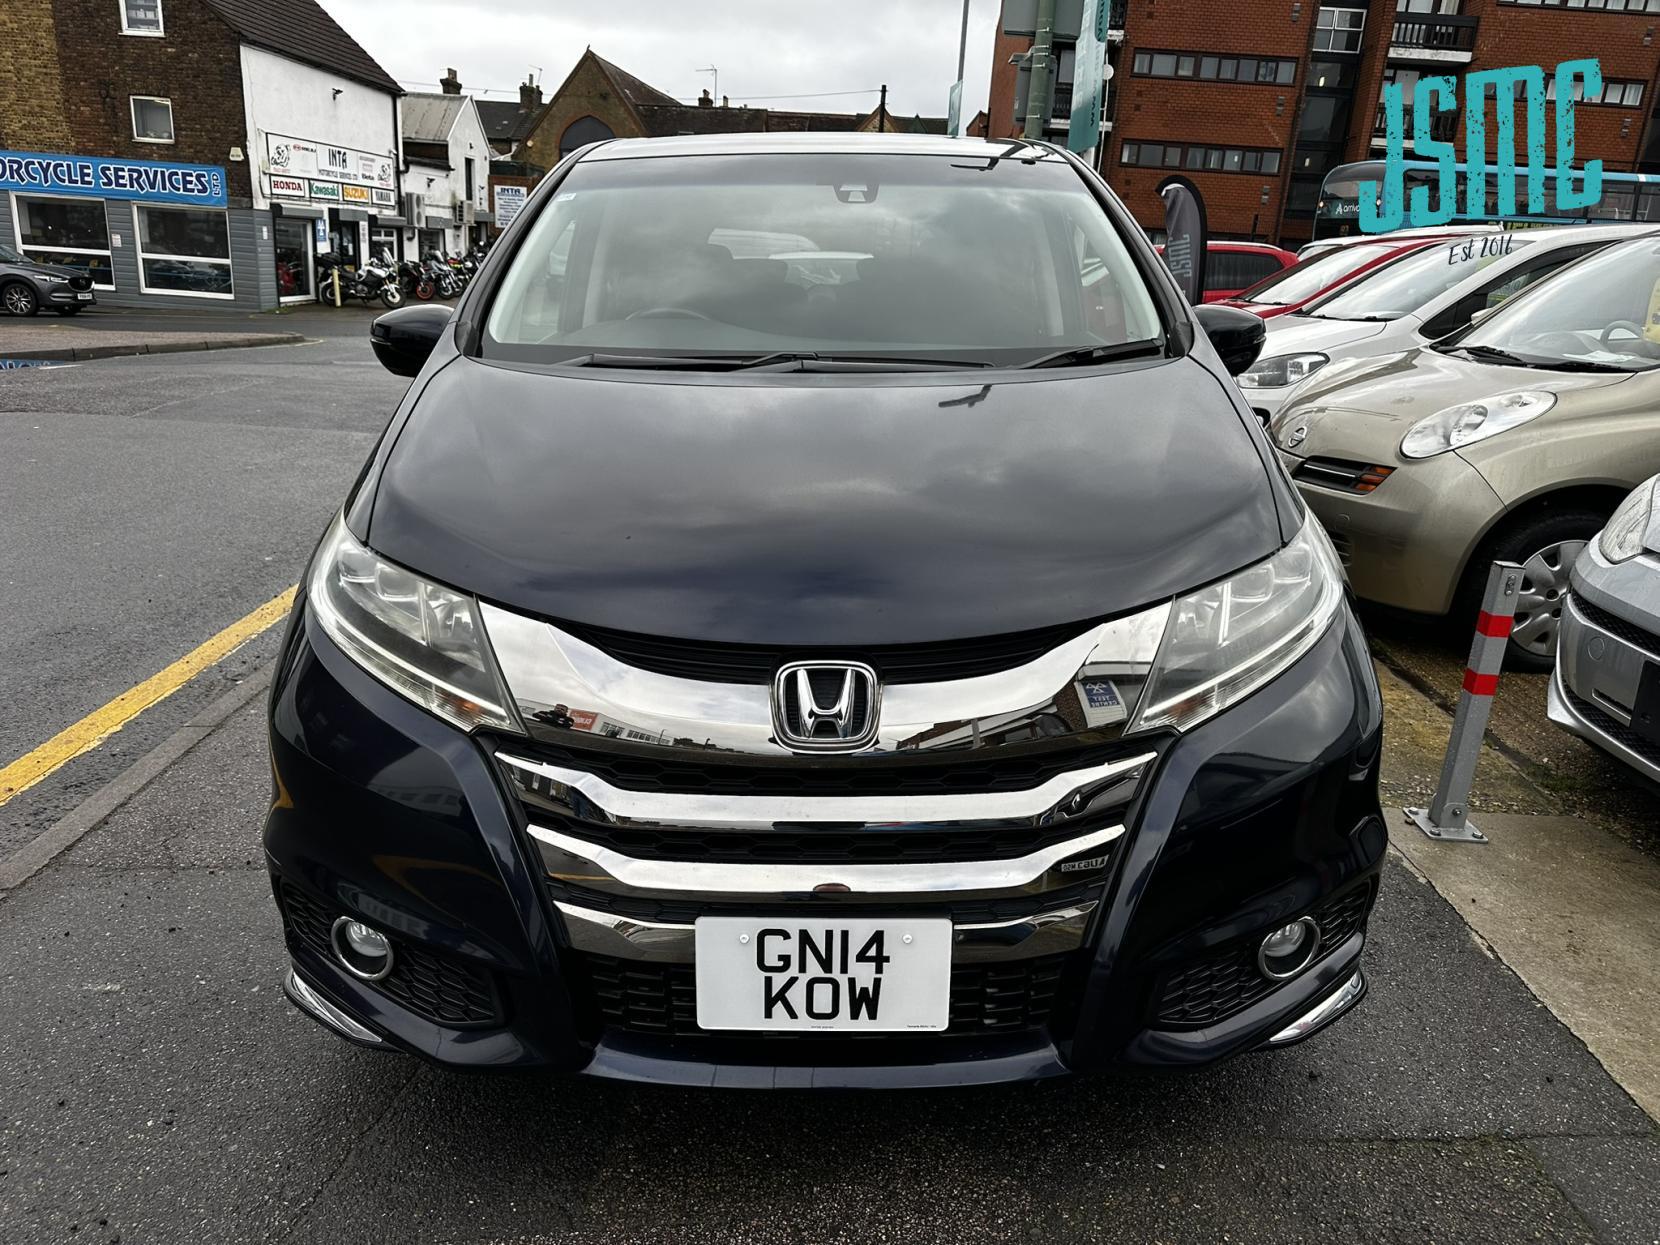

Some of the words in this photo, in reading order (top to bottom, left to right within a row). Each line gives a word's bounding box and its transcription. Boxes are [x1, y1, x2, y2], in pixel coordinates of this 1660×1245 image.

[328, 148, 347, 169] INTA
[99, 164, 210, 196] SERVICES
[212, 173, 221, 196] LTD
[272, 180, 303, 191] HONDA
[311, 181, 339, 197] Kawasaki
[344, 186, 368, 199] SUZUKI
[1167, 233, 1192, 278] JSMC
[756, 928, 890, 974] GN14
[764, 976, 882, 1020] KOW
